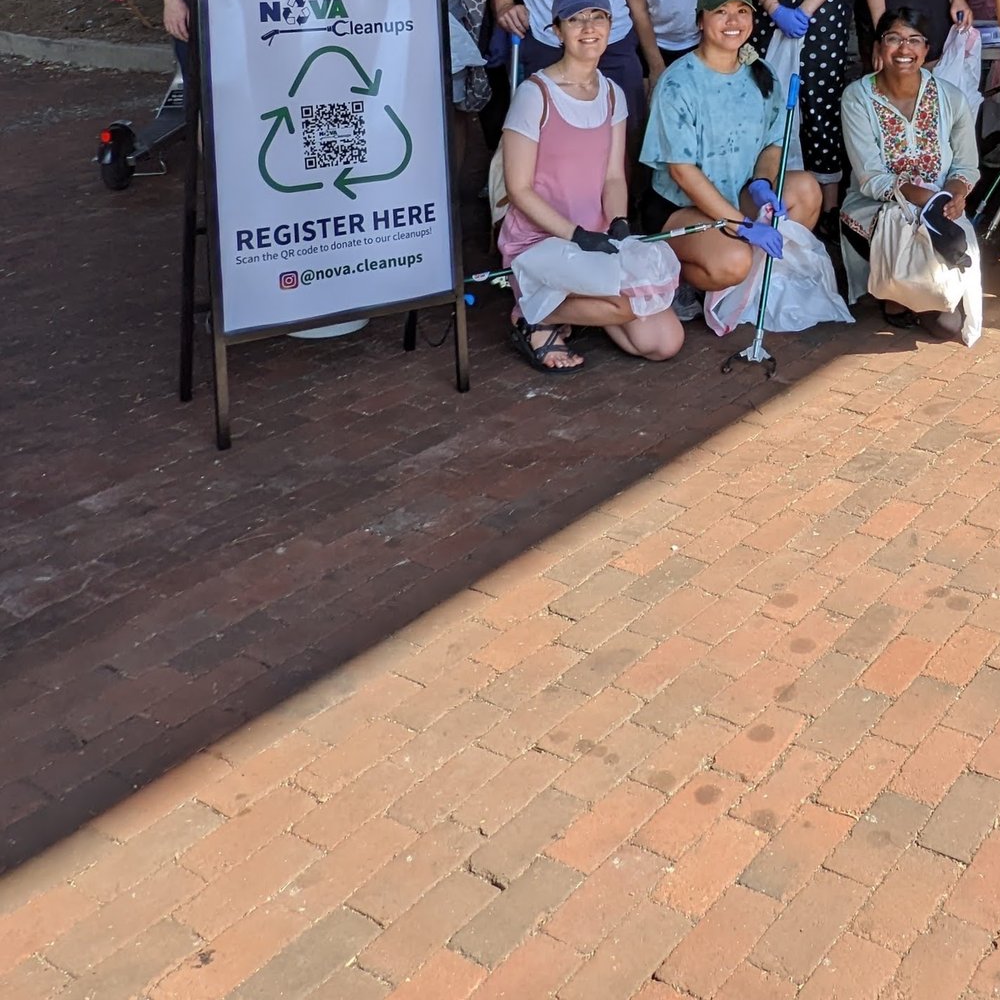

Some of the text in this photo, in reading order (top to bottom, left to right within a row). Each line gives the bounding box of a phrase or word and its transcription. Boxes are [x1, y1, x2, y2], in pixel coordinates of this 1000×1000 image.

[331, 19, 414, 36] Cleanups
[236, 202, 436, 251] REGISTER HERE
[235, 227, 432, 265] Scan the QR code to donate to our cleanups!
[300, 253, 423, 286] @nova.cleanups
